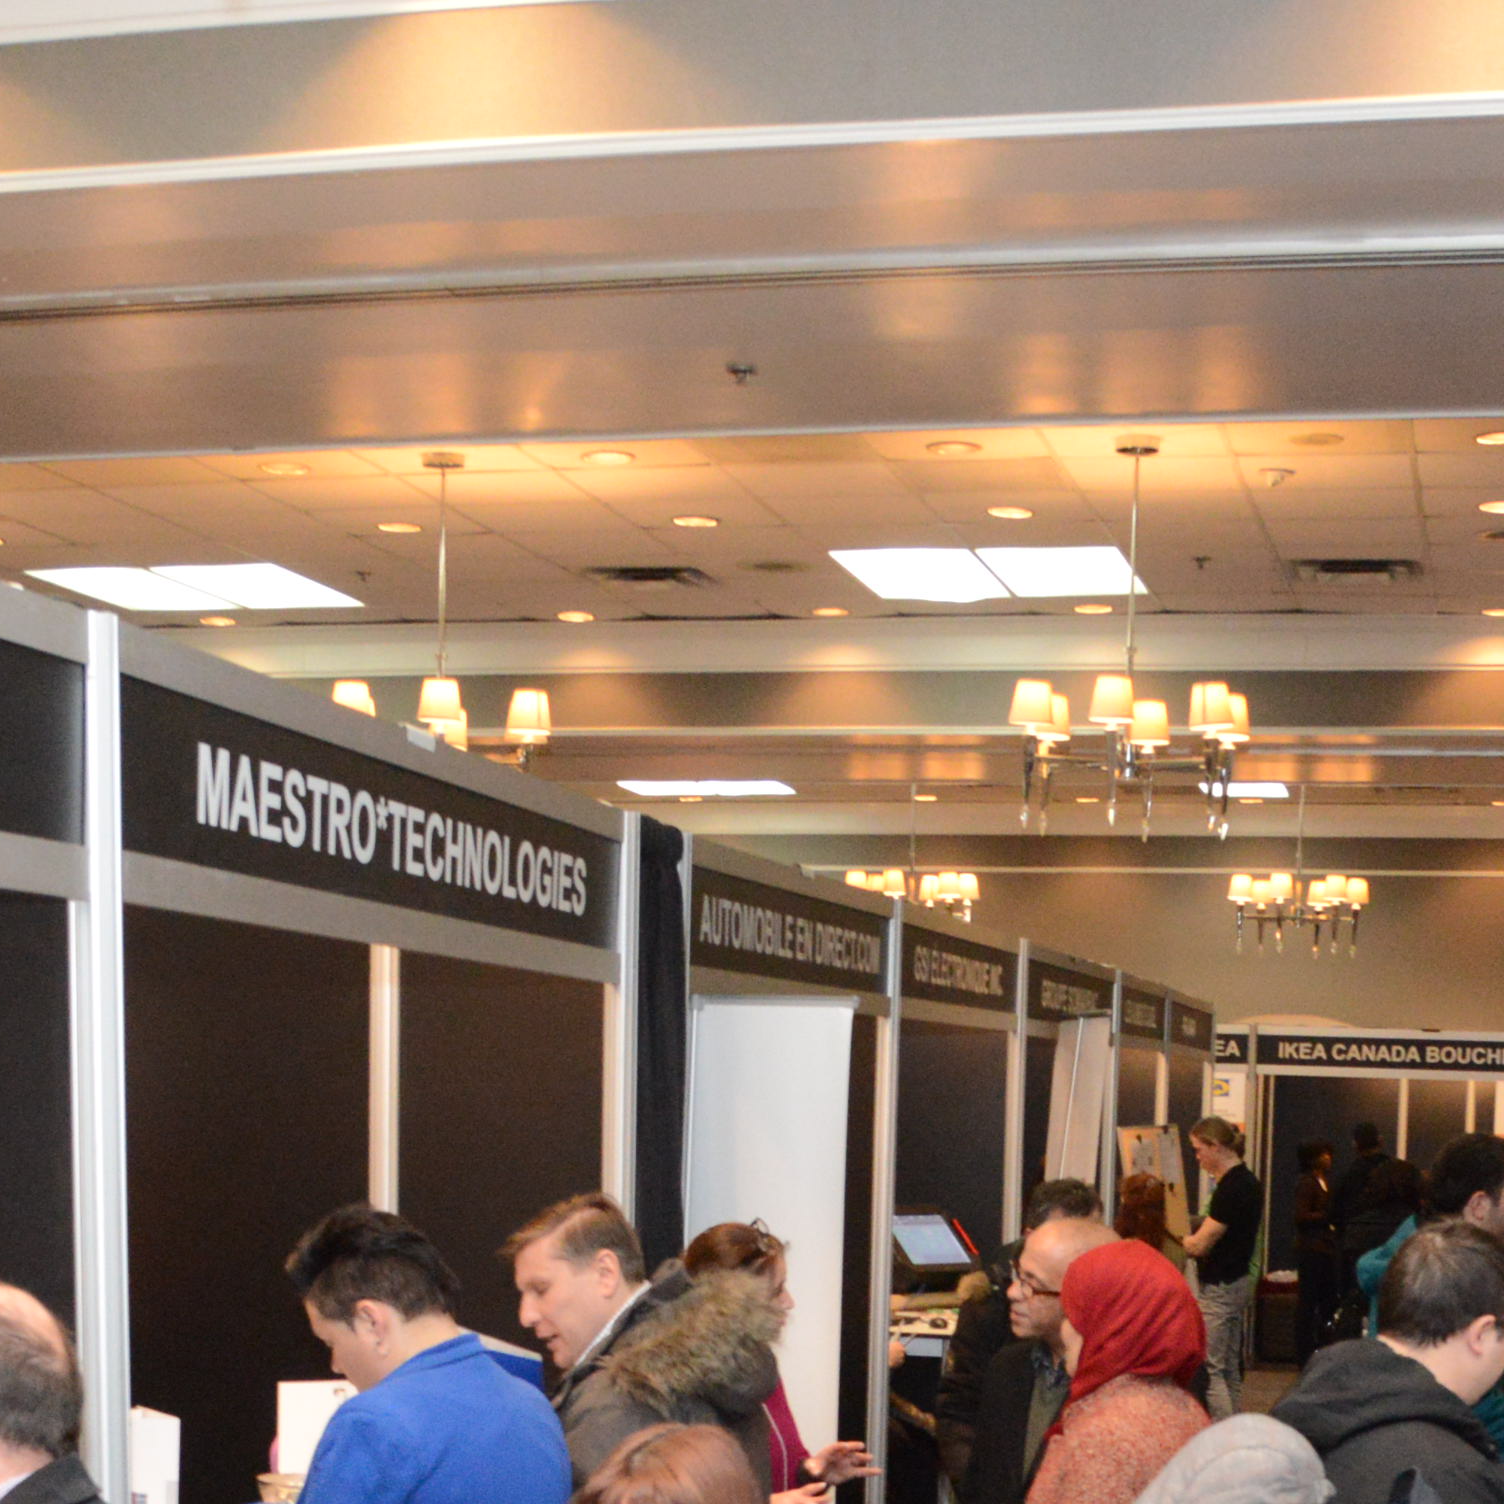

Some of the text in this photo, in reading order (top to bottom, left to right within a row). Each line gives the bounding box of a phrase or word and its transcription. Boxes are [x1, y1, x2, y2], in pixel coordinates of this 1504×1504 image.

[699, 893, 795, 960] AUTOMOBILE
[796, 916, 813, 963] EN
[1277, 1041, 1326, 1061] IKEA
[1331, 1042, 1422, 1064] CANADA
